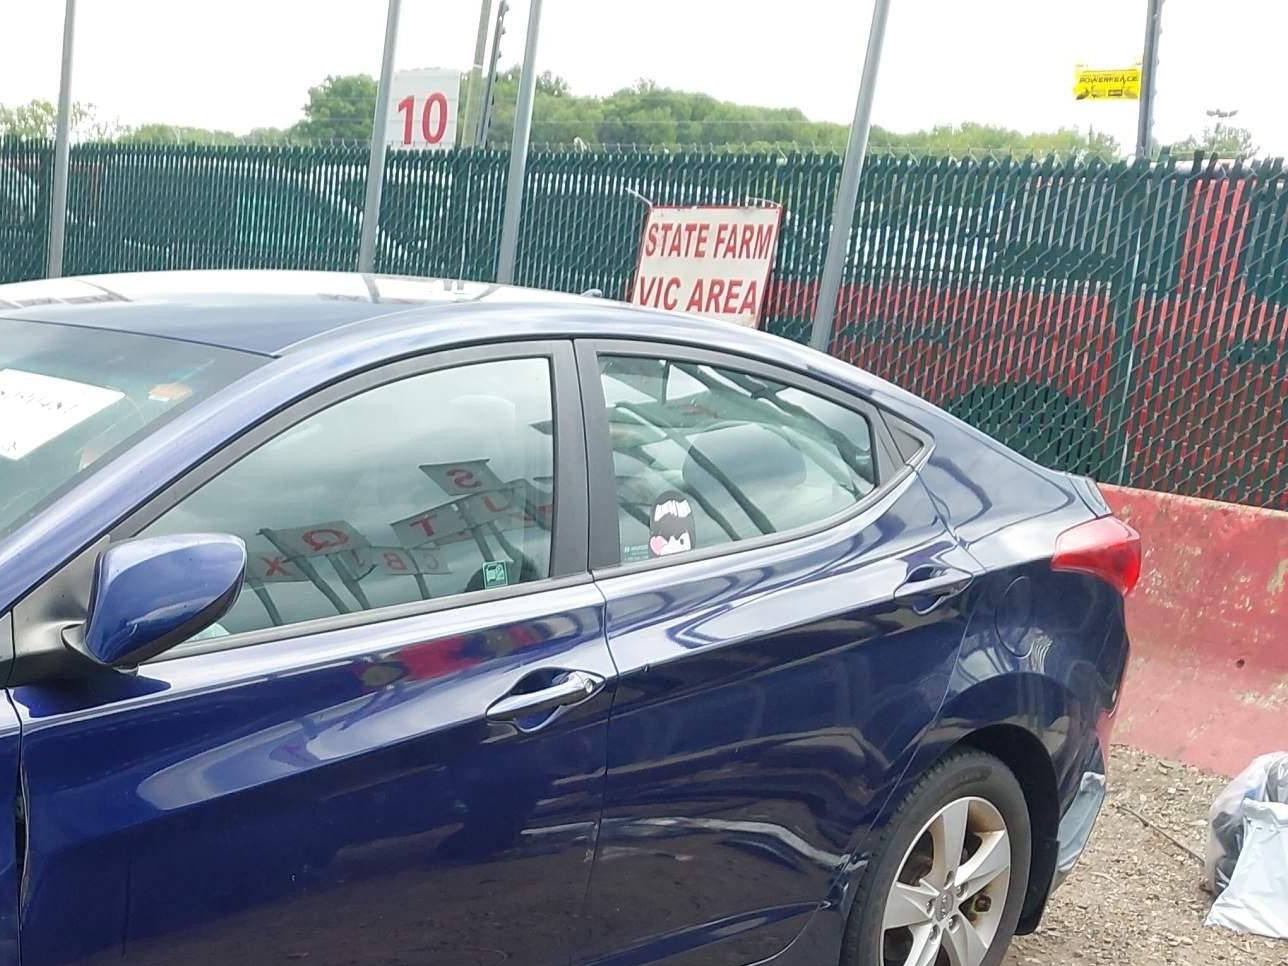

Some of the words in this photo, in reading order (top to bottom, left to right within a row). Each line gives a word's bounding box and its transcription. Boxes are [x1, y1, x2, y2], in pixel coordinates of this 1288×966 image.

[398, 92, 447, 145] 10
[645, 222, 710, 258] STATE
[713, 223, 774, 260] FARM
[639, 276, 681, 311] VIC
[685, 278, 758, 315] AREA
